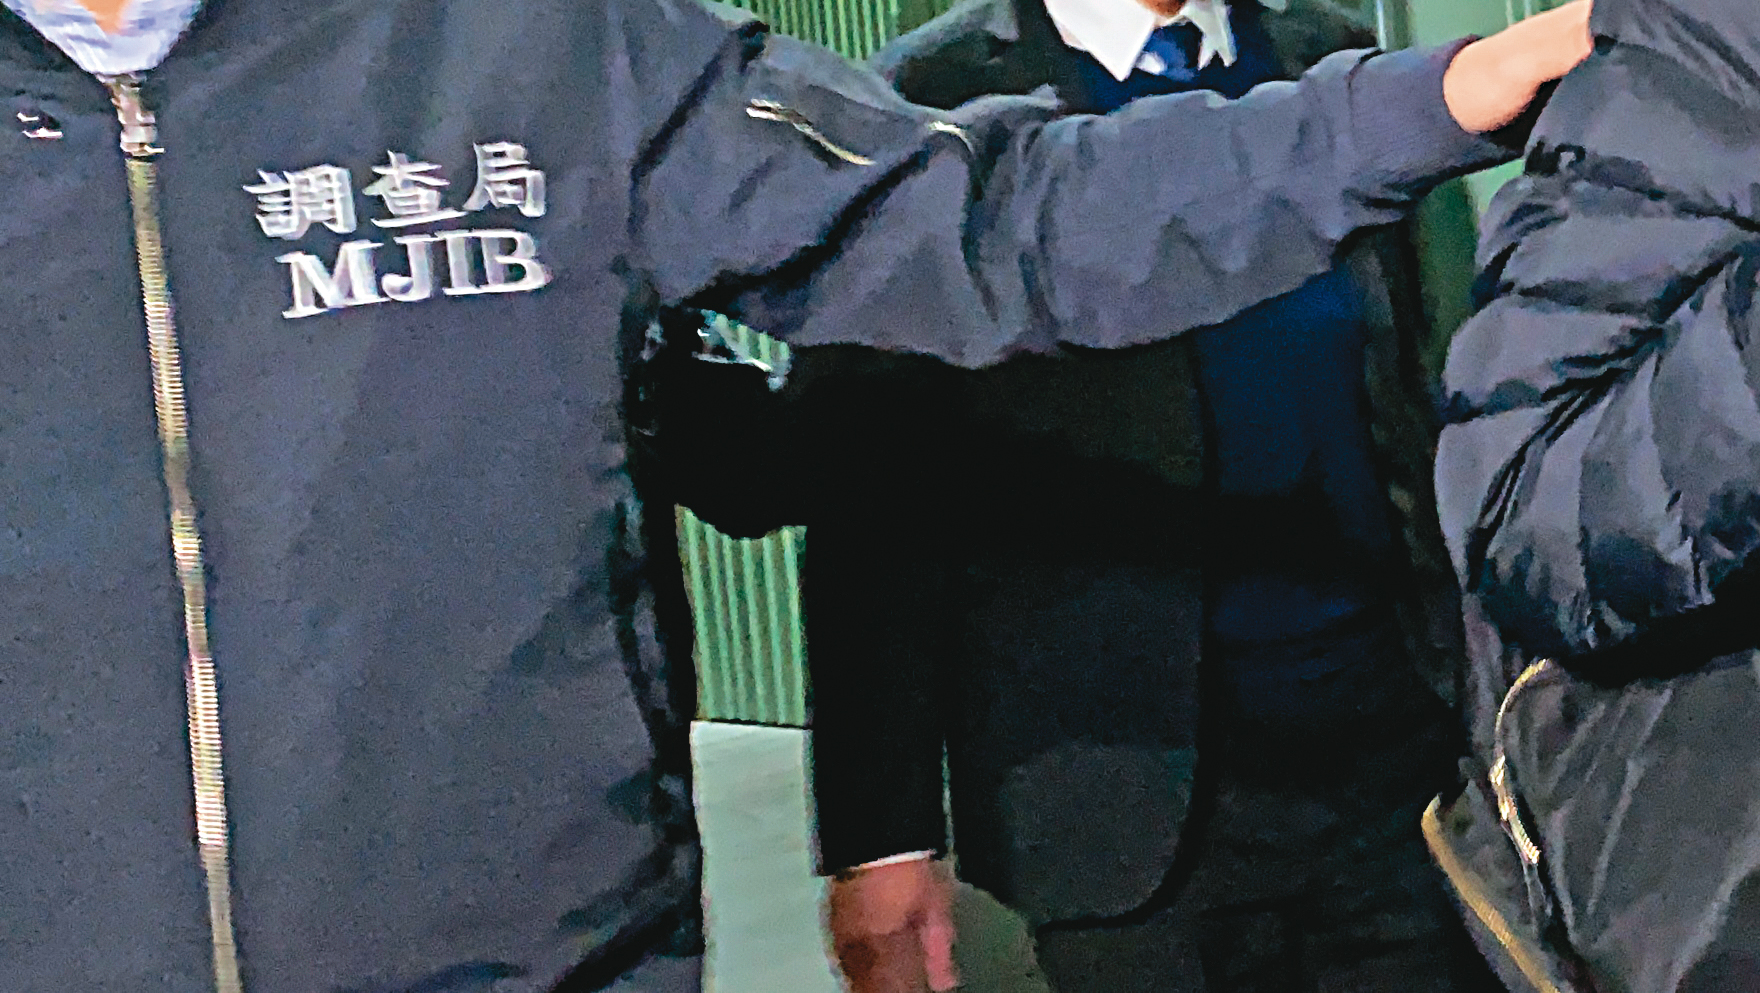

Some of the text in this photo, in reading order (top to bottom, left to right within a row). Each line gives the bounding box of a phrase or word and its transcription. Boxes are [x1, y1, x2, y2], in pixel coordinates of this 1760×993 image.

[242, 141, 547, 240] 調查局
[275, 228, 552, 319] MJIB
